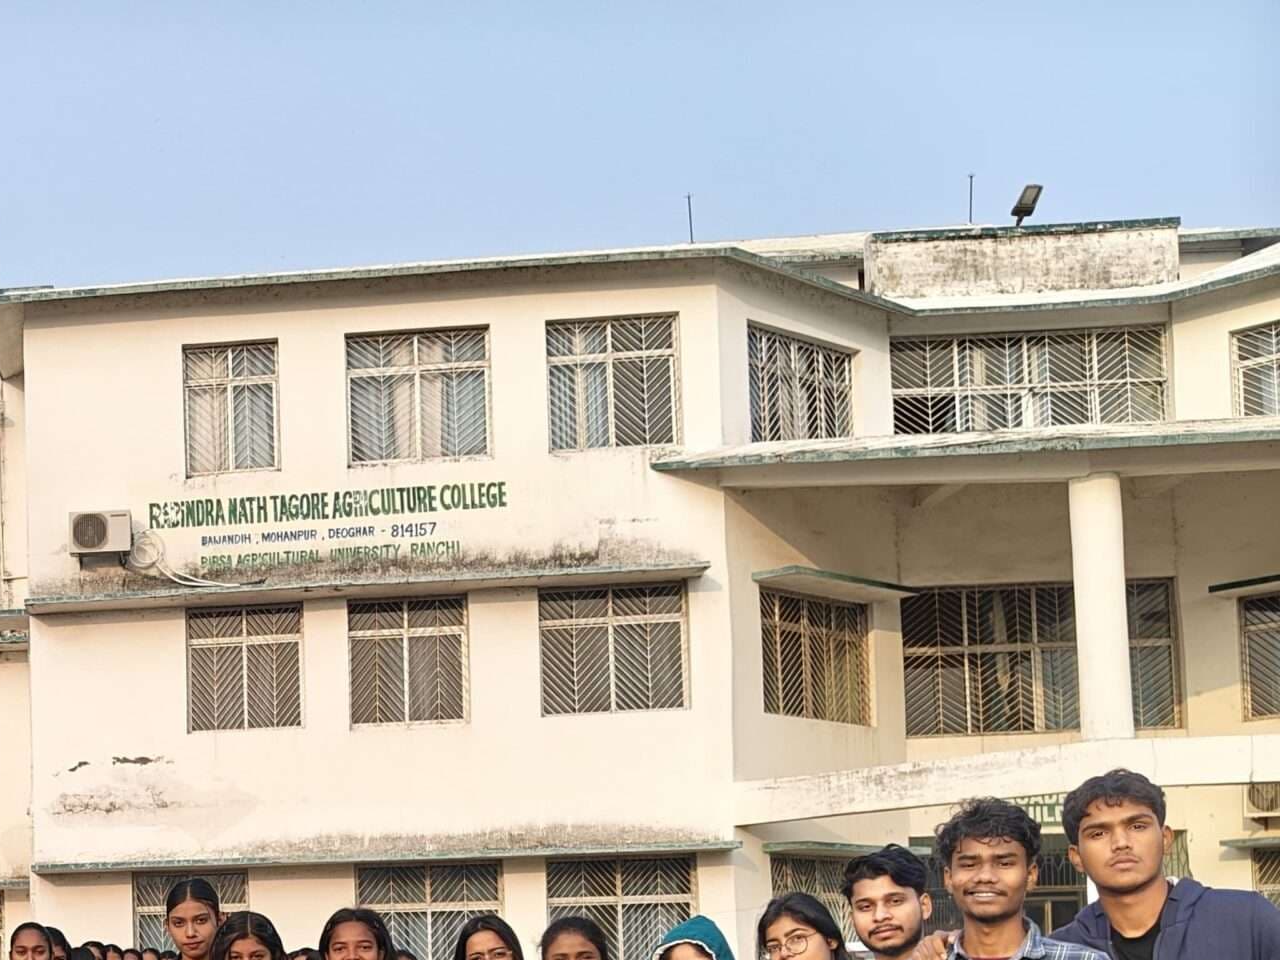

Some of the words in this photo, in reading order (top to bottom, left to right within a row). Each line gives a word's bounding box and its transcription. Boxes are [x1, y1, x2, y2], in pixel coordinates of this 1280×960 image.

[228, 495, 268, 525] NATH
[270, 492, 329, 522] TAGORE
[332, 485, 438, 519] AGRICULTURE
[440, 481, 508, 511] COLLEGE
[261, 529, 318, 543] MOHANPUR
[328, 526, 376, 539] DEOGHAR
[391, 522, 438, 538] 814157
[236, 549, 322, 568] AGRICULTURAL
[329, 544, 402, 563] UNIVERSITY
[410, 540, 461, 560] RANCHI
